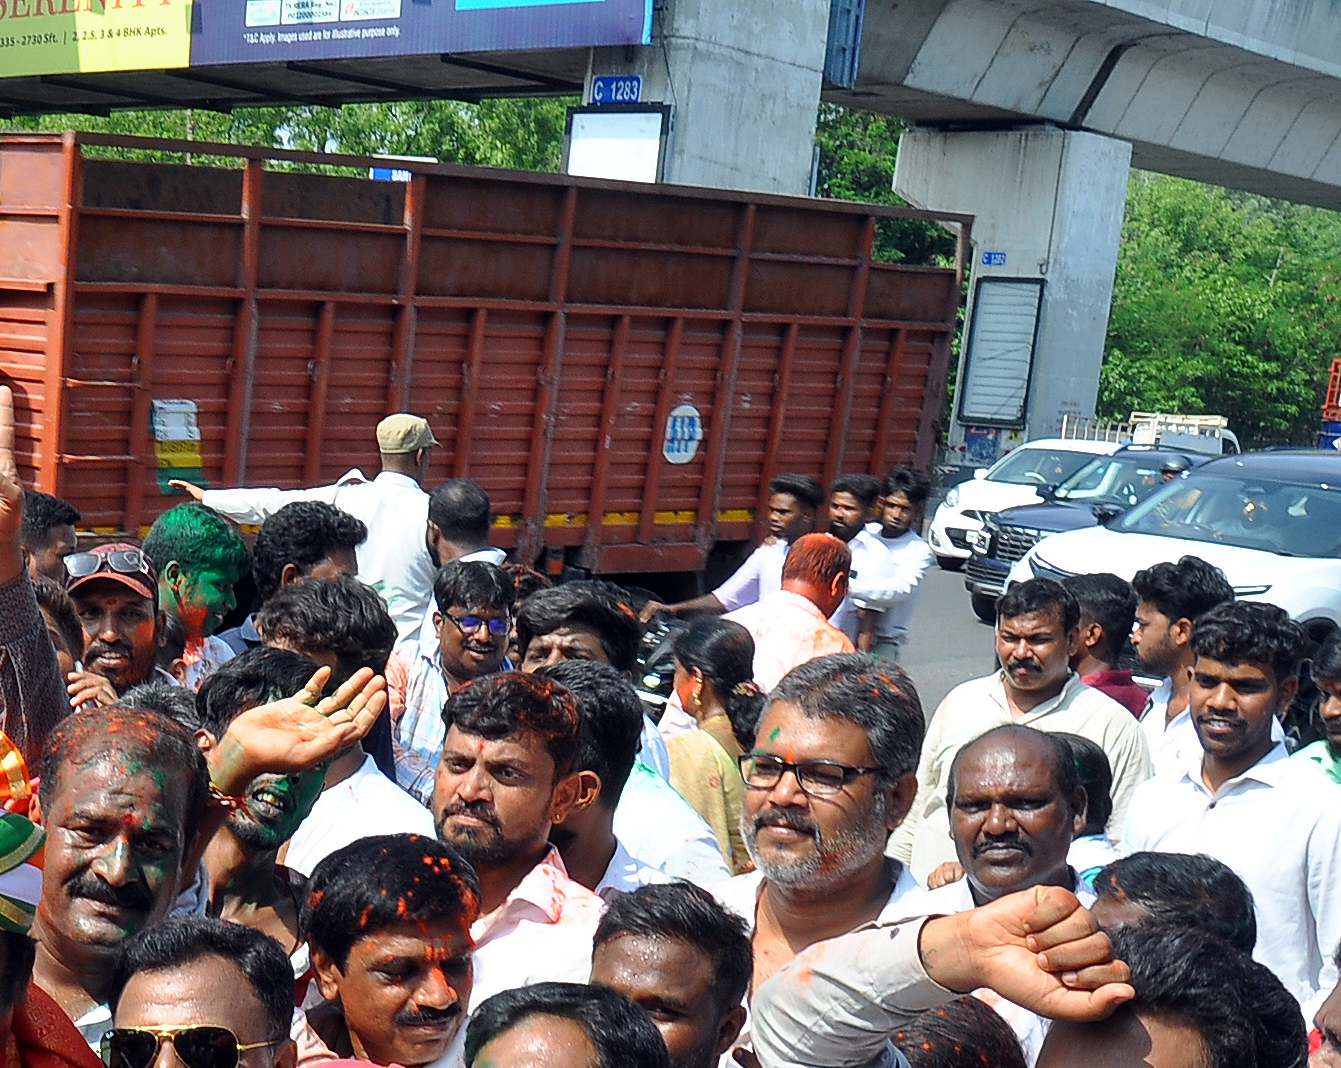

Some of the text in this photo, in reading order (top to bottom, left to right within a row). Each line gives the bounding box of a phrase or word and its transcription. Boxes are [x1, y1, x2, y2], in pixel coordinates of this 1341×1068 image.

[123, 27, 142, 38] BHK
[593, 81, 639, 101] C 1283
